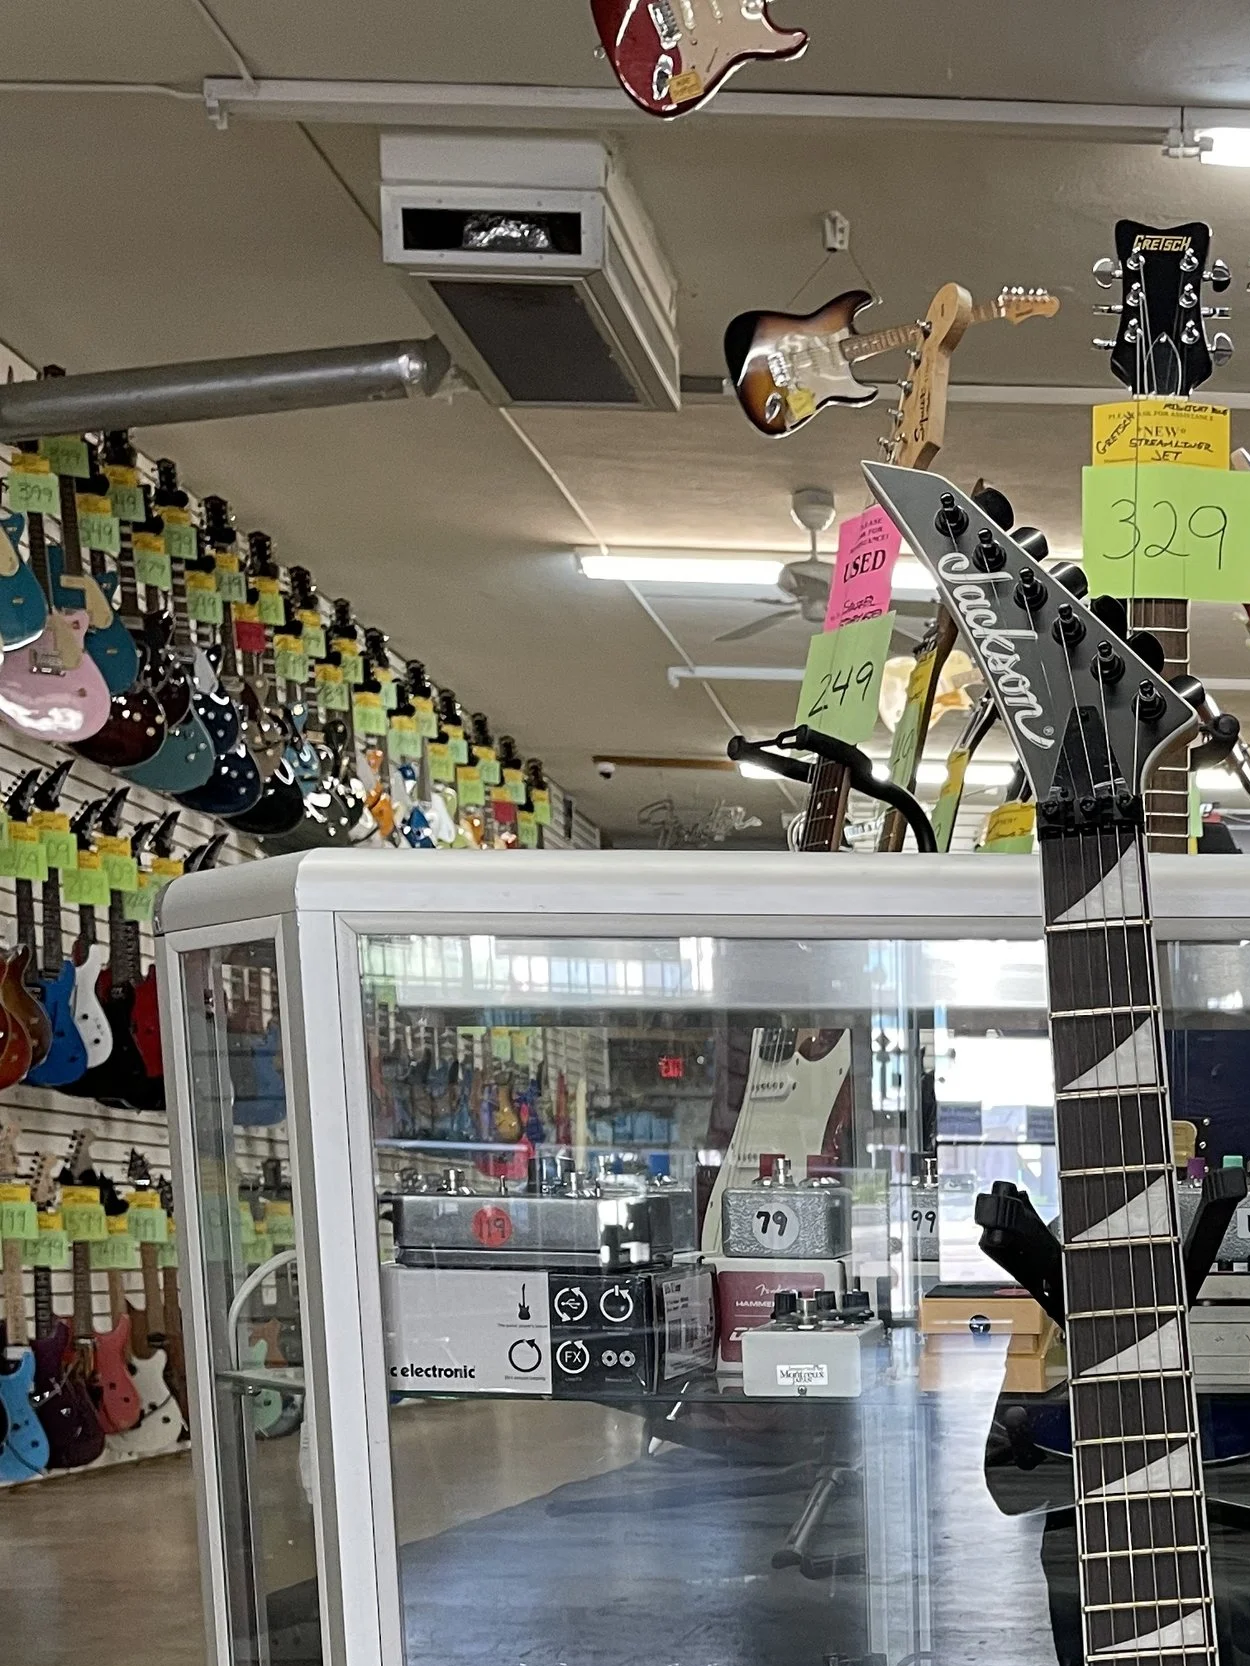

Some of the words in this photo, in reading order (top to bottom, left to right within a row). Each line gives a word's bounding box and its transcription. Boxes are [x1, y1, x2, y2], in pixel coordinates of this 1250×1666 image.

[1133, 234, 1192, 252] GRETSCH
[1143, 425, 1178, 437] NEW
[1150, 450, 1183, 462] JET
[1102, 498, 1228, 570] 329
[843, 549, 887, 584] USED
[936, 550, 1056, 750] Jackson
[808, 661, 874, 718] 249
[478, 1215, 507, 1240] 119
[756, 1210, 789, 1236] 79
[911, 1209, 937, 1233] 99
[564, 1350, 581, 1363] FX
[400, 1363, 476, 1379] electronic
